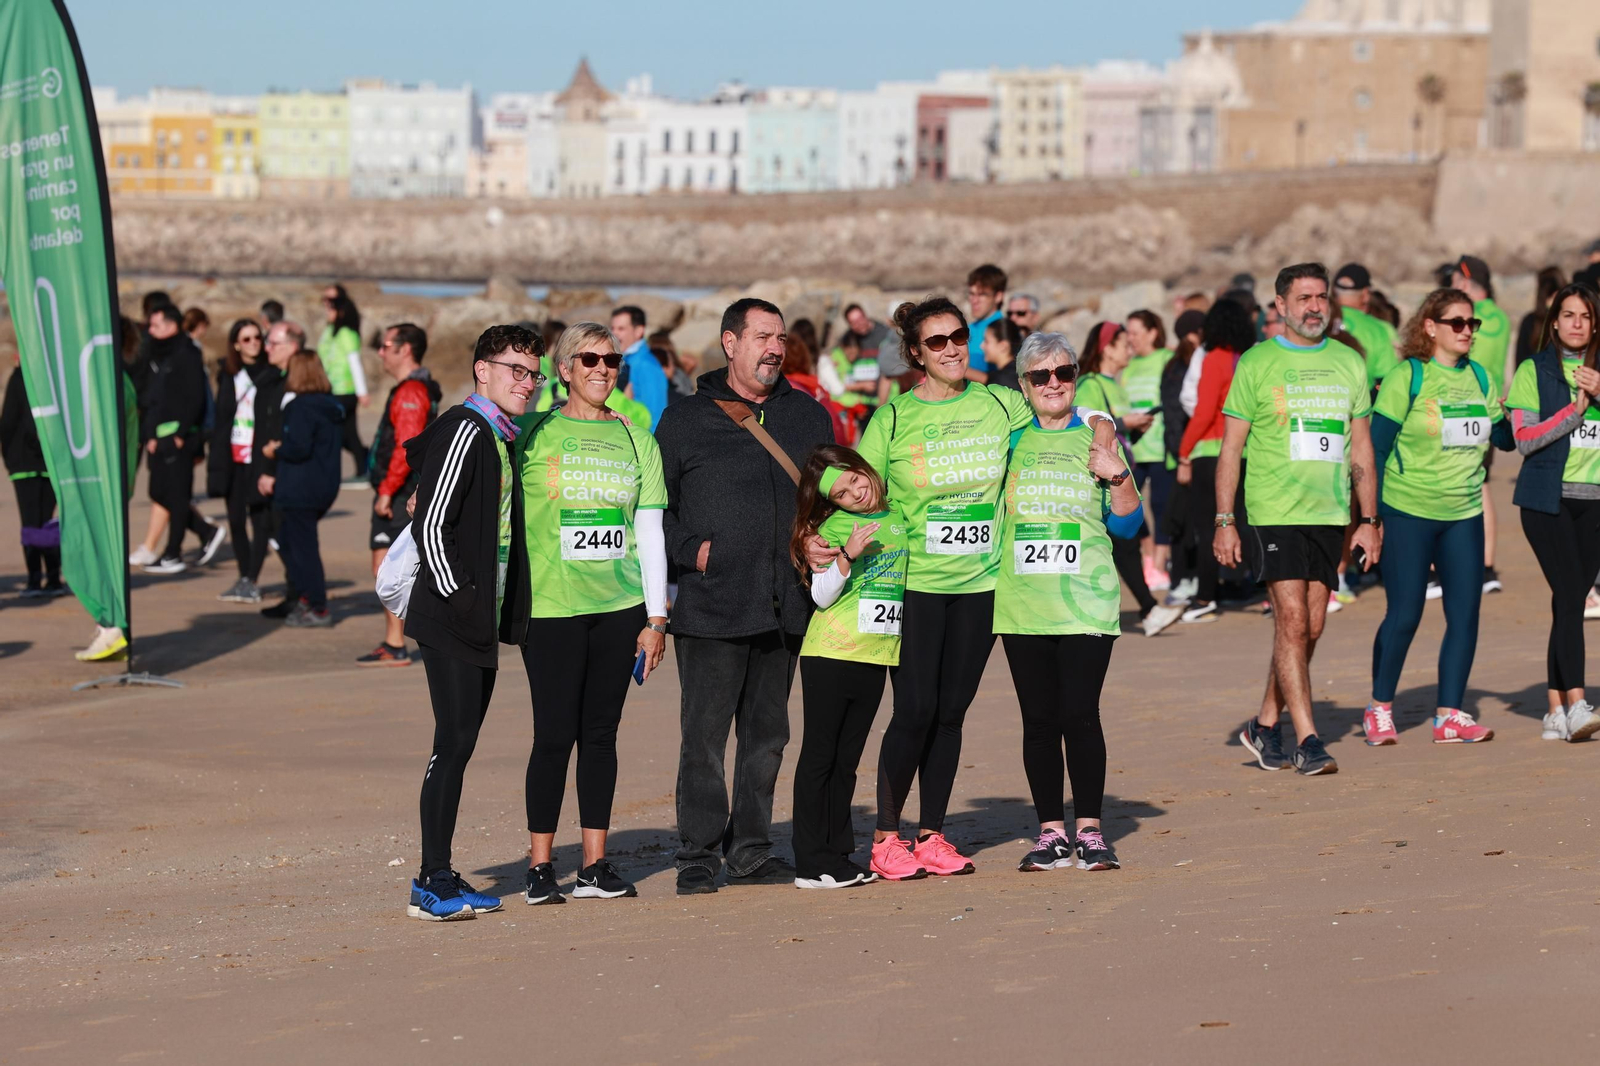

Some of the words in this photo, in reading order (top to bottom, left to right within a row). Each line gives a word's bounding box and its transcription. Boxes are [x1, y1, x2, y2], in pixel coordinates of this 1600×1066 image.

[1286, 384, 1302, 394] En
[1305, 384, 1349, 395] marcha
[1287, 396, 1336, 408] contra
[1338, 398, 1350, 409] el
[1463, 421, 1480, 436] 10
[926, 441, 945, 452] En
[947, 433, 1000, 449] marcha
[1319, 437, 1329, 452] 9
[563, 453, 581, 465] En
[585, 456, 635, 472] marcha
[928, 450, 986, 468] contra
[988, 446, 1002, 460] el
[544, 454, 560, 500] CÁDIZ
[562, 469, 620, 484] contra
[931, 465, 1003, 487] cáncer
[1019, 469, 1036, 480] En
[1040, 470, 1094, 486] marcha
[562, 482, 636, 504] cáncer
[1016, 483, 1075, 498] contra
[1077, 488, 1091, 502] el
[1017, 497, 1090, 519] cáncer
[574, 530, 623, 549] 2440
[940, 525, 990, 544] 2438
[880, 547, 908, 561] marh
[1024, 544, 1077, 563] 2470
